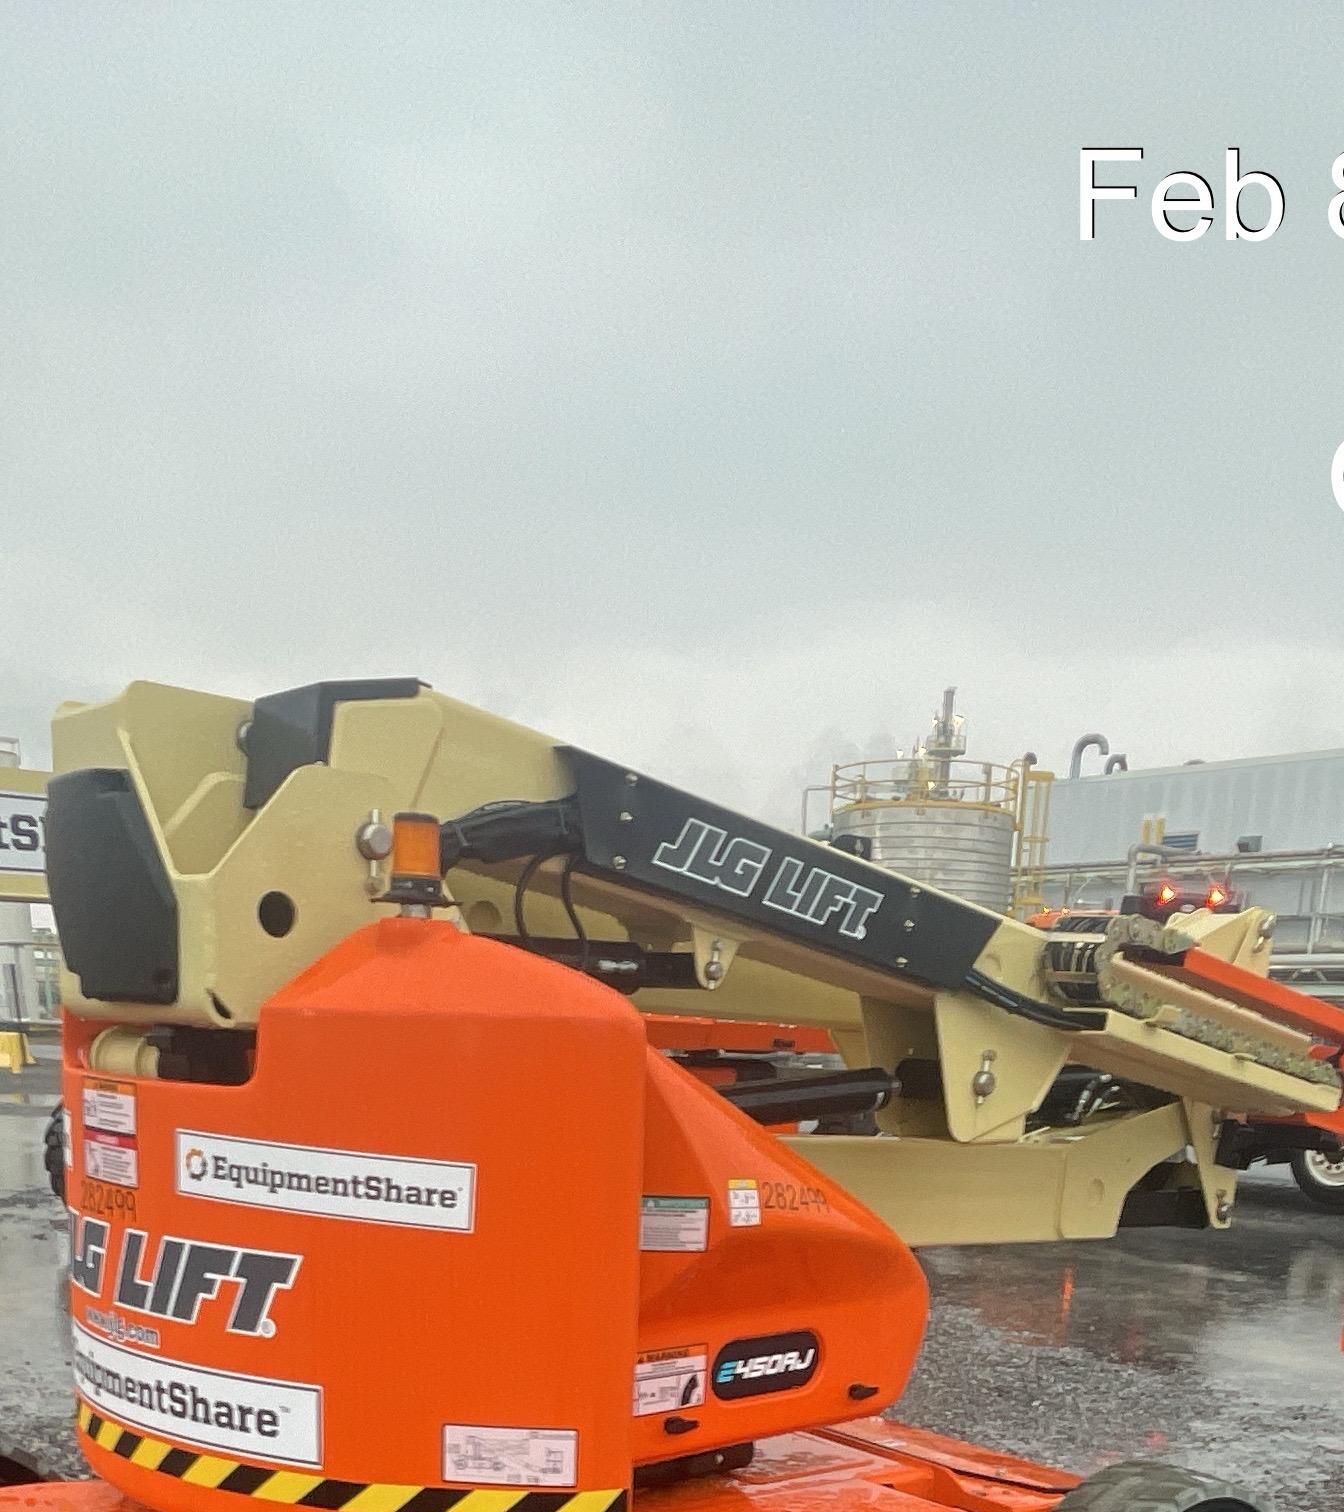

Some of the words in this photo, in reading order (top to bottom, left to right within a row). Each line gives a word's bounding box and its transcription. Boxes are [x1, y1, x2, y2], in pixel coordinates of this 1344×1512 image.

[652, 817, 773, 898] JLG
[762, 856, 886, 941] LIFT
[80, 1179, 137, 1222] 282499
[211, 1154, 458, 1209] EquipmentShare
[113, 1227, 303, 1338] LIFT
[716, 1347, 816, 1384] E450AJ
